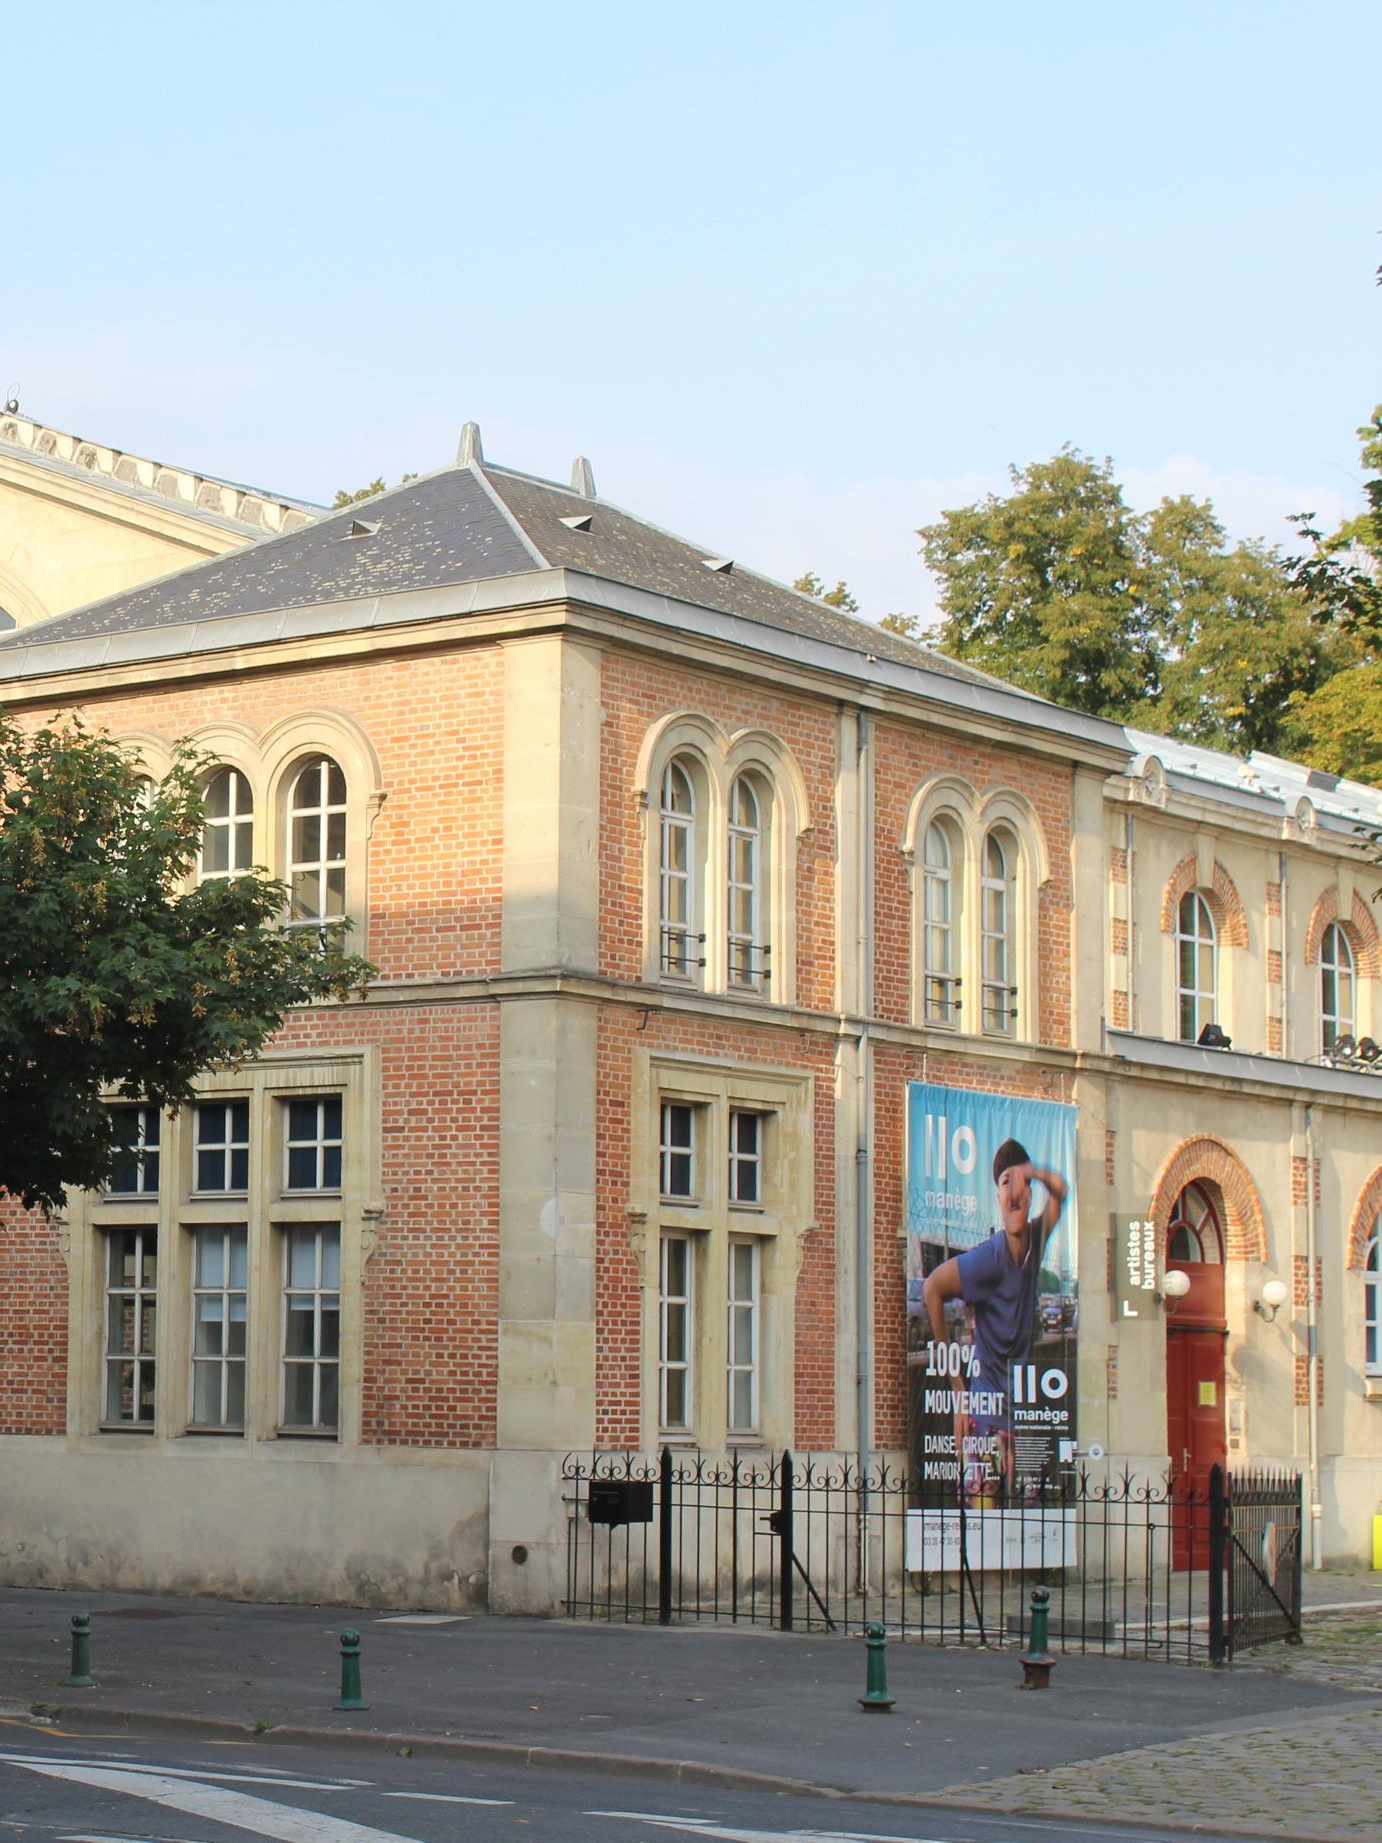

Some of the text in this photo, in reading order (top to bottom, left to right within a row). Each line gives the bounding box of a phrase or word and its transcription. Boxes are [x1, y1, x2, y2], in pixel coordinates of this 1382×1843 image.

[924, 1187, 978, 1217] manège
[1126, 1221, 1141, 1286] artistes
[1141, 1221, 1156, 1290] bureaux
[925, 1340, 981, 1378] 100%
[924, 1389, 1004, 1416] MOUVEMENT
[1014, 1406, 1070, 1424] manège
[924, 1435, 959, 1457] DANSE,
[962, 1436, 1000, 1457] CIRQUE,
